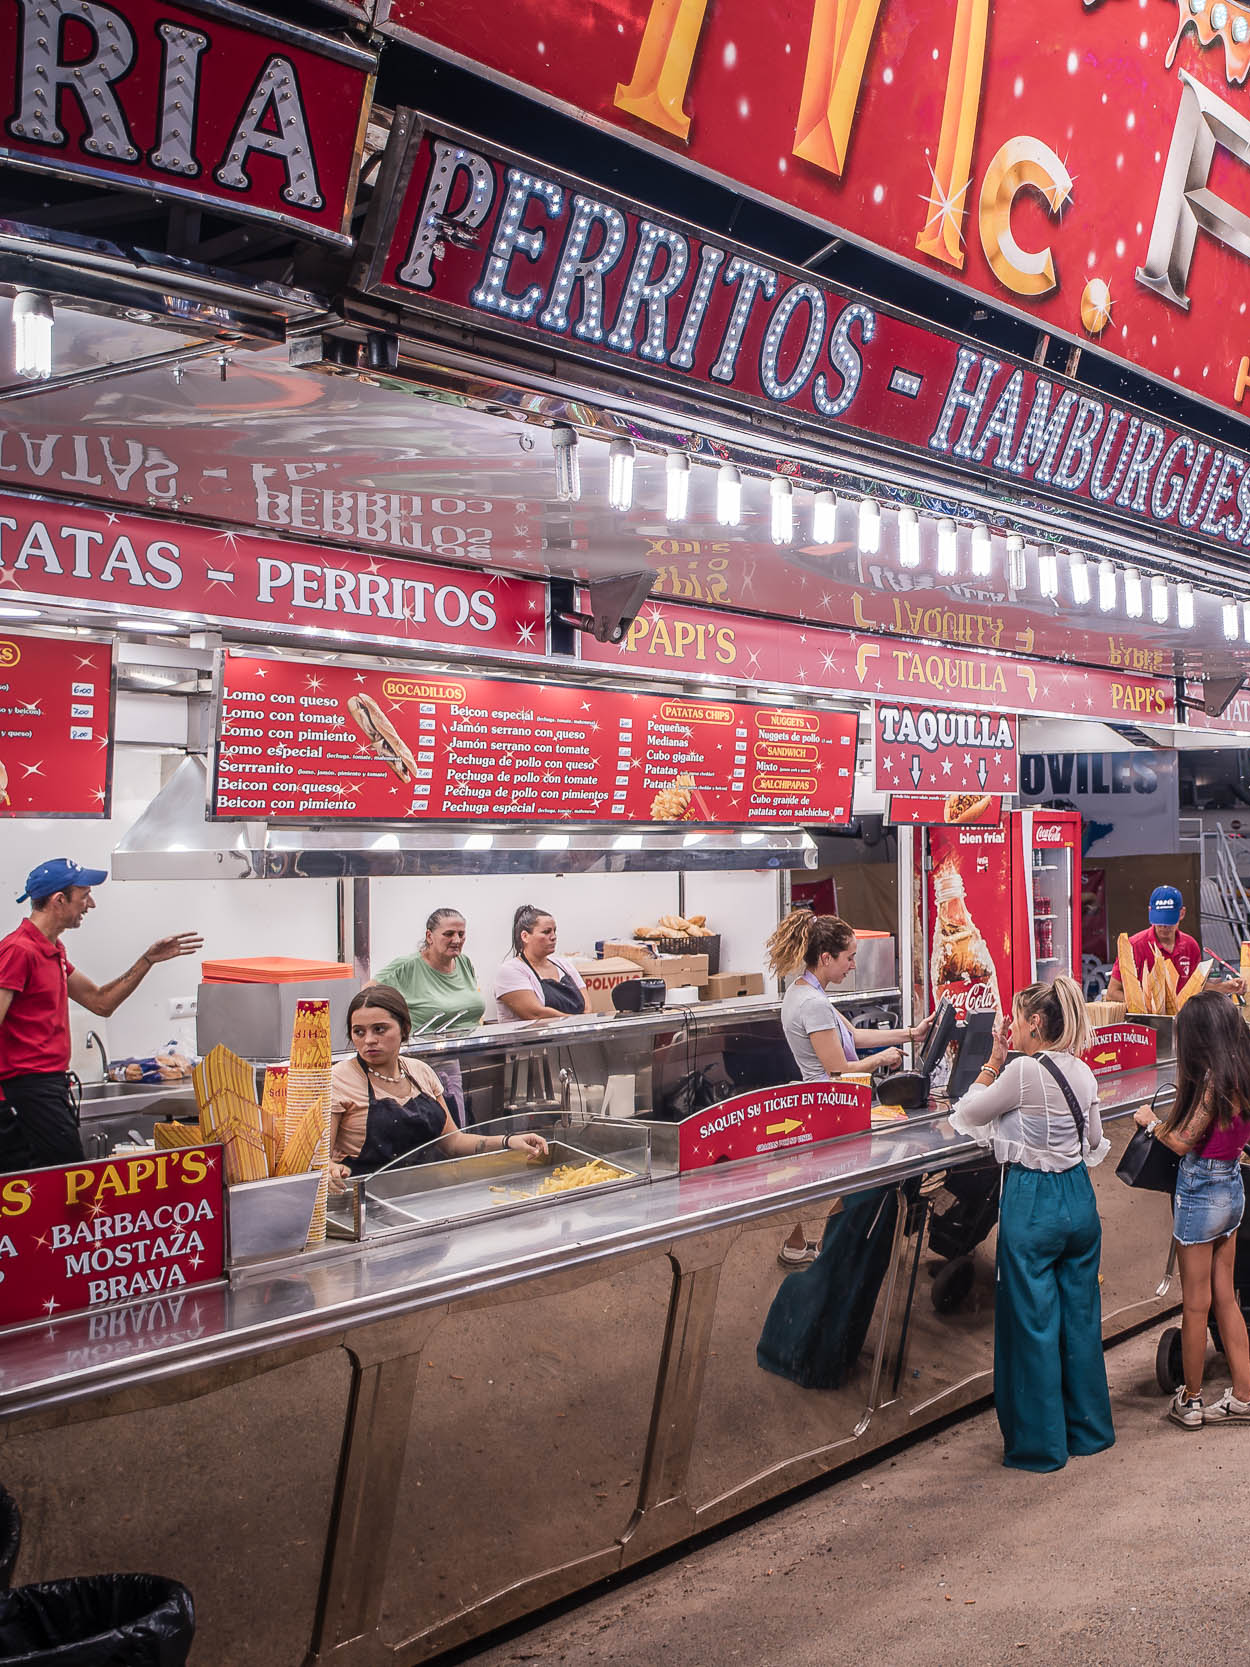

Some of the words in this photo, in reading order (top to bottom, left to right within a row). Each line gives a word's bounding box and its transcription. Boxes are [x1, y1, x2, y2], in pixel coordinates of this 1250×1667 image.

[8, 0, 327, 210] RIA
[399, 139, 876, 417] PERRITOS
[256, 557, 497, 632] PERRITOS
[626, 616, 737, 664] PAPI'S
[892, 650, 1007, 693] TAQUILLA
[1111, 683, 1166, 714] PAPI'S
[223, 686, 266, 702] Lomo
[270, 692, 296, 704] con
[299, 694, 339, 708] queso
[387, 683, 463, 700] BOCADILLOS
[222, 705, 265, 720] Lomo
[269, 711, 295, 722] con
[299, 711, 346, 725] tomate
[450, 705, 489, 718] Beicon
[492, 709, 535, 722] especial
[666, 706, 703, 719] PATATAS
[705, 709, 730, 721] CHIPS
[450, 721, 488, 734] Jamón
[491, 726, 532, 738] serrano
[534, 728, 554, 738] con
[556, 729, 586, 741] queso
[647, 720, 690, 734] Pequeñas
[771, 717, 805, 728] NUGGETS
[879, 705, 1015, 751] TAQUILLA
[220, 723, 263, 738] Lomo
[268, 728, 294, 740] con
[298, 729, 356, 743] pimiento
[647, 735, 689, 747] Medianas
[758, 729, 789, 741] Nuggets
[791, 732, 800, 741] de
[802, 733, 820, 744] pollo
[219, 741, 262, 755] Lomo
[266, 746, 323, 760] especial
[449, 737, 487, 750] Jamón
[490, 741, 531, 752] serrano
[534, 743, 553, 753] con
[555, 743, 590, 755] tomate
[767, 746, 806, 758] SANDWICH
[448, 753, 496, 767] Pechuga
[499, 754, 513, 766] de
[515, 756, 542, 769] pollo
[544, 758, 563, 768] con
[565, 760, 595, 771] queso
[646, 749, 670, 760] Cubo
[672, 752, 705, 763] gigante
[218, 759, 294, 775] Serrranito
[645, 764, 678, 775] Patatas
[756, 760, 778, 771] Mixto
[447, 769, 494, 783] Pechuga
[497, 770, 511, 782] de
[513, 772, 540, 785] pollo
[543, 774, 561, 784] con
[564, 775, 598, 785] tomate
[643, 778, 676, 789] Patatas
[760, 778, 810, 791] SALCHIPAPAS
[217, 777, 268, 792] Beicon
[272, 780, 297, 793] con
[301, 780, 340, 795] queso
[444, 785, 492, 799] Pechuga
[494, 786, 508, 797] de
[511, 787, 538, 800] pollo
[541, 789, 559, 799] con
[561, 789, 609, 801] pimientos
[216, 795, 266, 809] Beicon
[270, 798, 295, 809] con
[299, 798, 357, 812] pimiento
[442, 800, 489, 814] Pechuga
[492, 802, 535, 815] especial
[750, 794, 771, 804] Cubo
[773, 795, 799, 806] grande
[800, 796, 810, 805] de
[748, 803, 777, 817] patatas
[779, 808, 792, 816] con
[794, 808, 830, 817] salchichas
[960, 833, 981, 844] bien
[984, 832, 1005, 844] fría!
[1113, 1032, 1122, 1043] EN
[1123, 1032, 1149, 1046] TAQUILLA
[699, 1108, 745, 1139] SAQUEN
[747, 1103, 762, 1118] SU
[764, 1094, 799, 1113] TICKET
[801, 1093, 814, 1106] EN
[817, 1092, 859, 1107] TAQUILLA
[64, 1150, 209, 1205] PAPI'S
[51, 1198, 215, 1249] BARBACOA
[64, 1230, 205, 1278] MOSTAZA
[88, 1264, 187, 1305] BRAVA
